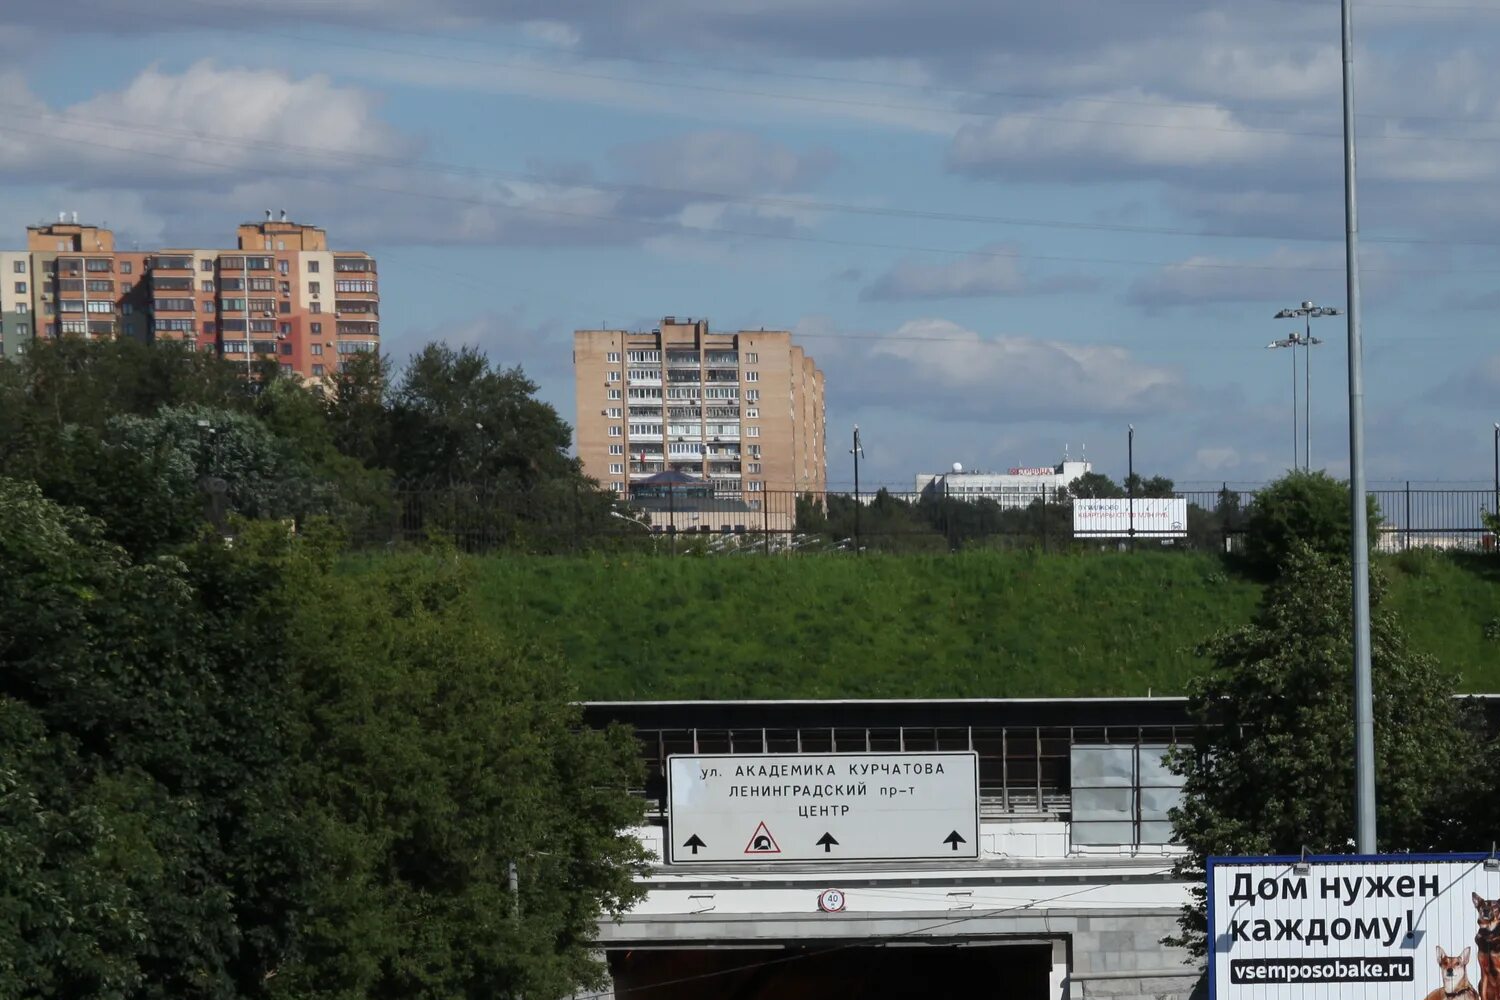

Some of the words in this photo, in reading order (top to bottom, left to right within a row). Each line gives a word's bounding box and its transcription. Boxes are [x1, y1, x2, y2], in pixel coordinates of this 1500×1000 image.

[701, 768, 722, 780] ул.
[735, 765, 836, 778] АКАДЕМИКА
[849, 763, 945, 776] КУРЧАТОВА
[729, 782, 867, 797] ЛЕНИНГРАДСКИЙ
[880, 785, 915, 798] пр-т
[798, 805, 850, 819] ЦЕНТР
[1229, 873, 1308, 907] Дом
[1320, 874, 1439, 906] нужен
[1231, 910, 1414, 947] каждому!
[1234, 961, 1410, 982] vsemposobake.ru
